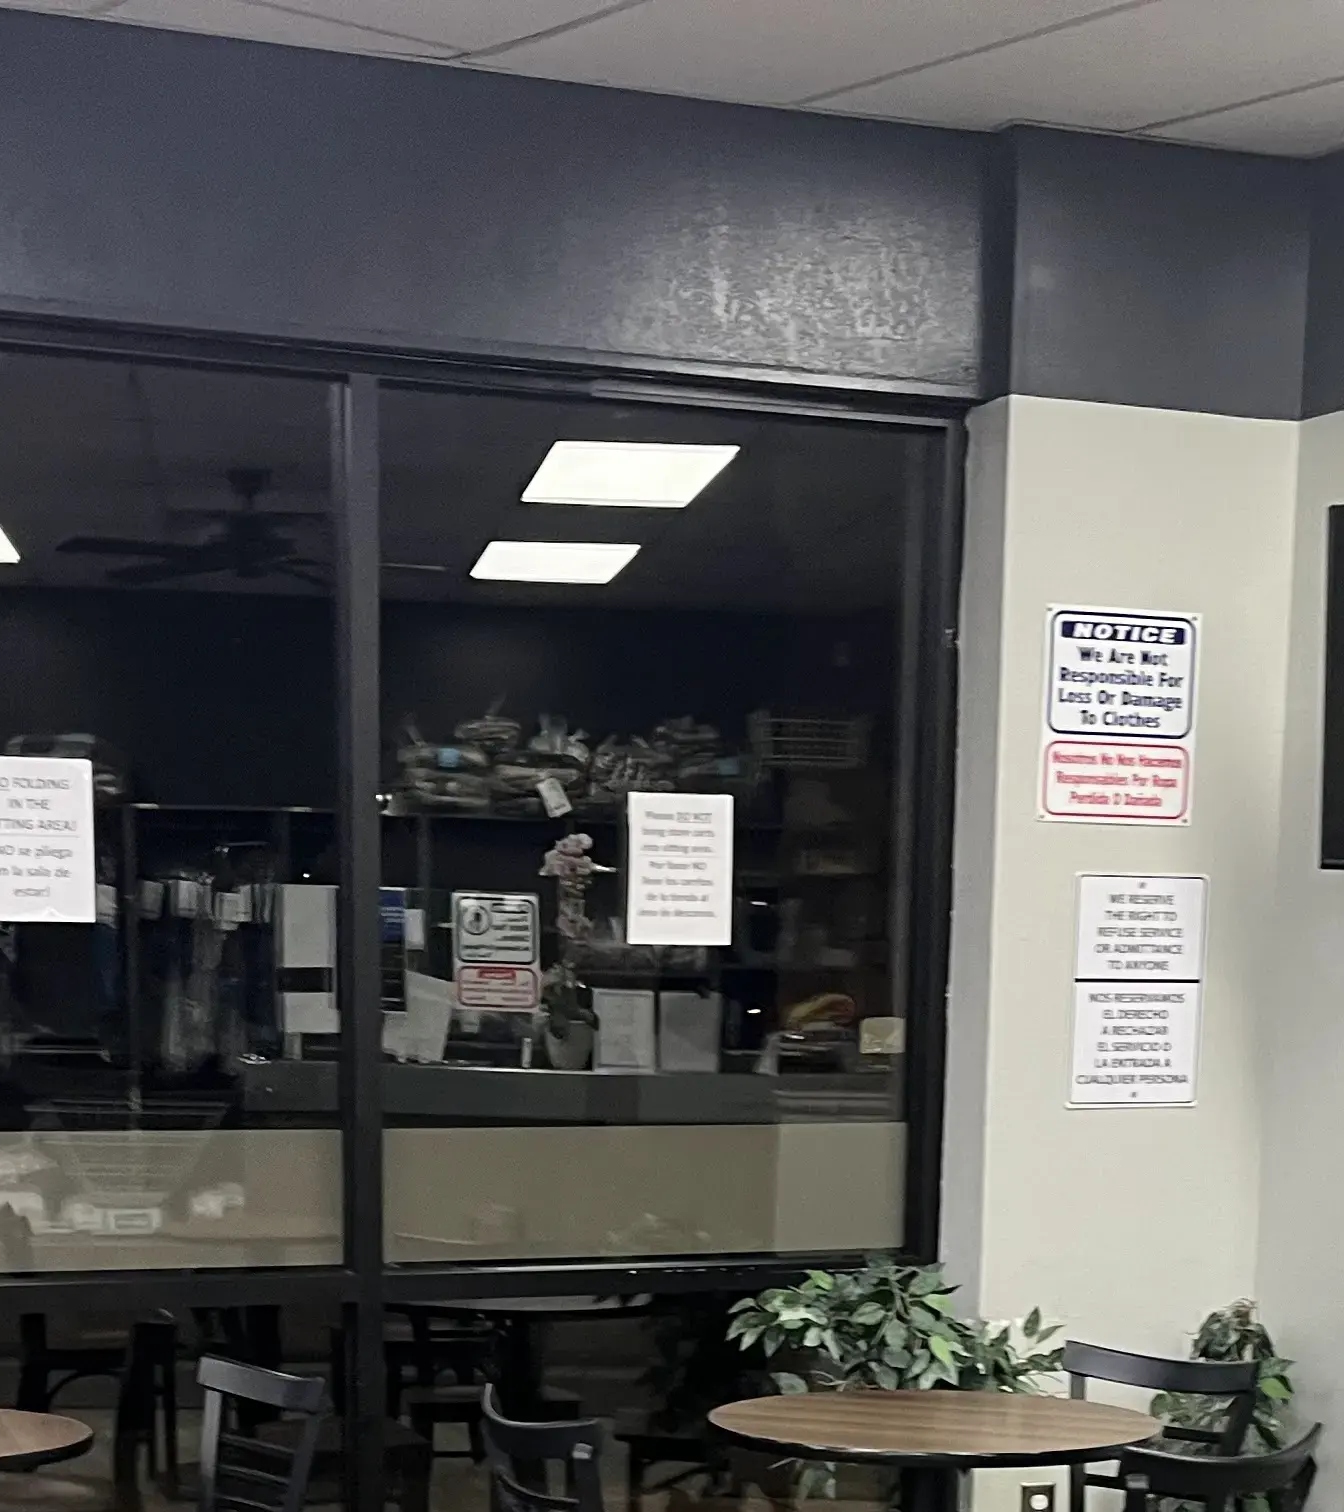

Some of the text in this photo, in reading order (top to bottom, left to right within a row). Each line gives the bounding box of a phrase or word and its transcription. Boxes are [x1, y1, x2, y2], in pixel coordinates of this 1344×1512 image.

[1073, 622, 1177, 644] NOTICE
[1077, 647, 1168, 667] We Are Not
[1059, 667, 1184, 688] Responsible For
[1058, 688, 1182, 711] Loss Or Damage
[1081, 710, 1160, 728] To Clothes
[12, 777, 71, 789] FOLDING
[7, 798, 51, 810] IN THE
[1109, 894, 1174, 905] WE RESERVE
[1105, 911, 1177, 921] THE RIGHT TO
[1097, 927, 1183, 938] REFUSE SERVICE
[1094, 943, 1183, 954] OR ADMITTANCE
[1107, 960, 1169, 971] TO ANYONE
[1089, 993, 1185, 1003] NOS RESERVAMOS
[1118, 1010, 1169, 1019] DERECHO
[1076, 1075, 1188, 1085] CUALQUIER PERSONA
